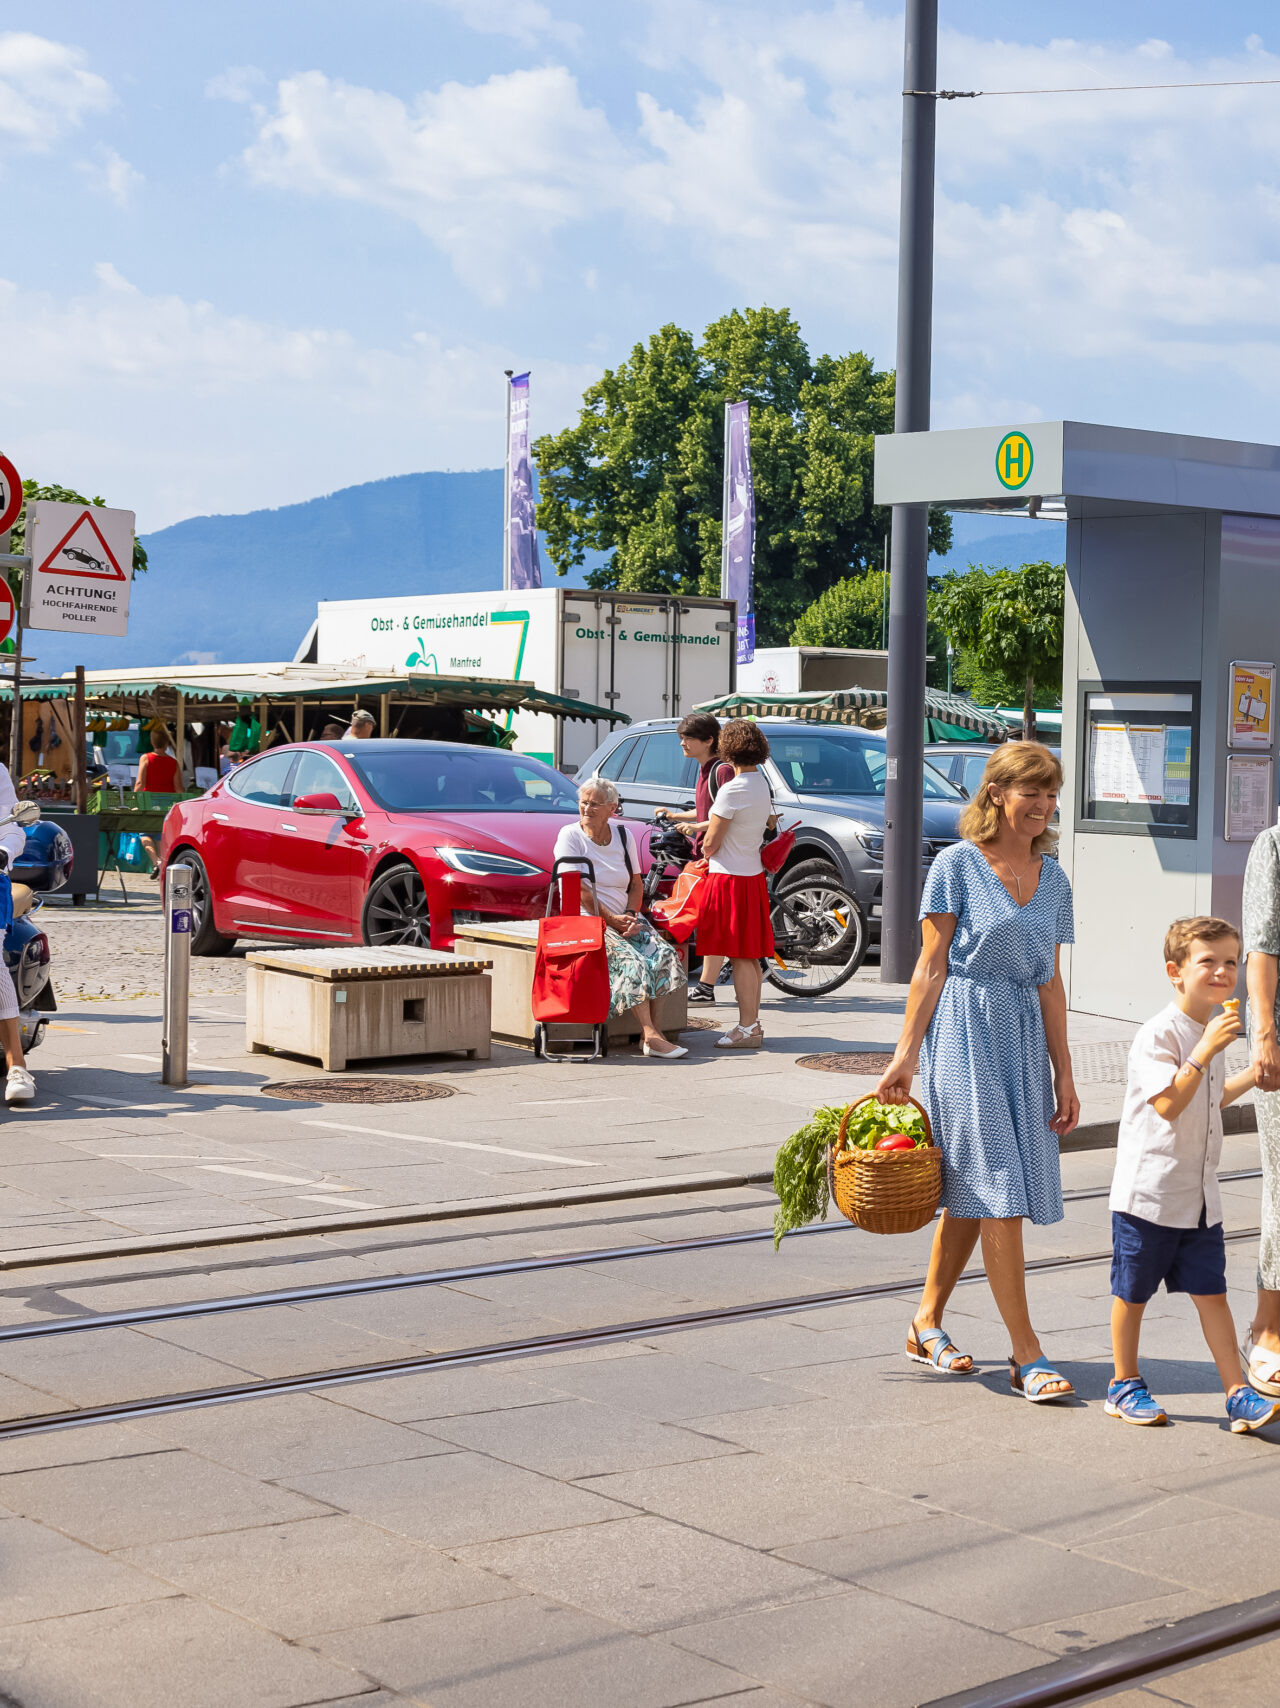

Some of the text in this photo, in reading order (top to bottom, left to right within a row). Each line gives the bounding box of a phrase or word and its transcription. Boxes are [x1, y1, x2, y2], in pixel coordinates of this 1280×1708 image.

[1005, 443, 1023, 478] H
[46, 584, 117, 601] ACHTUNG!
[42, 599, 118, 614] HOCHFAHRENDE
[62, 612, 97, 623] POLLER
[371, 617, 394, 632] Obst
[402, 616, 410, 630] &
[412, 611, 489, 630] Gemüsehandel
[618, 630, 628, 641] &
[450, 656, 482, 668] Manfred
